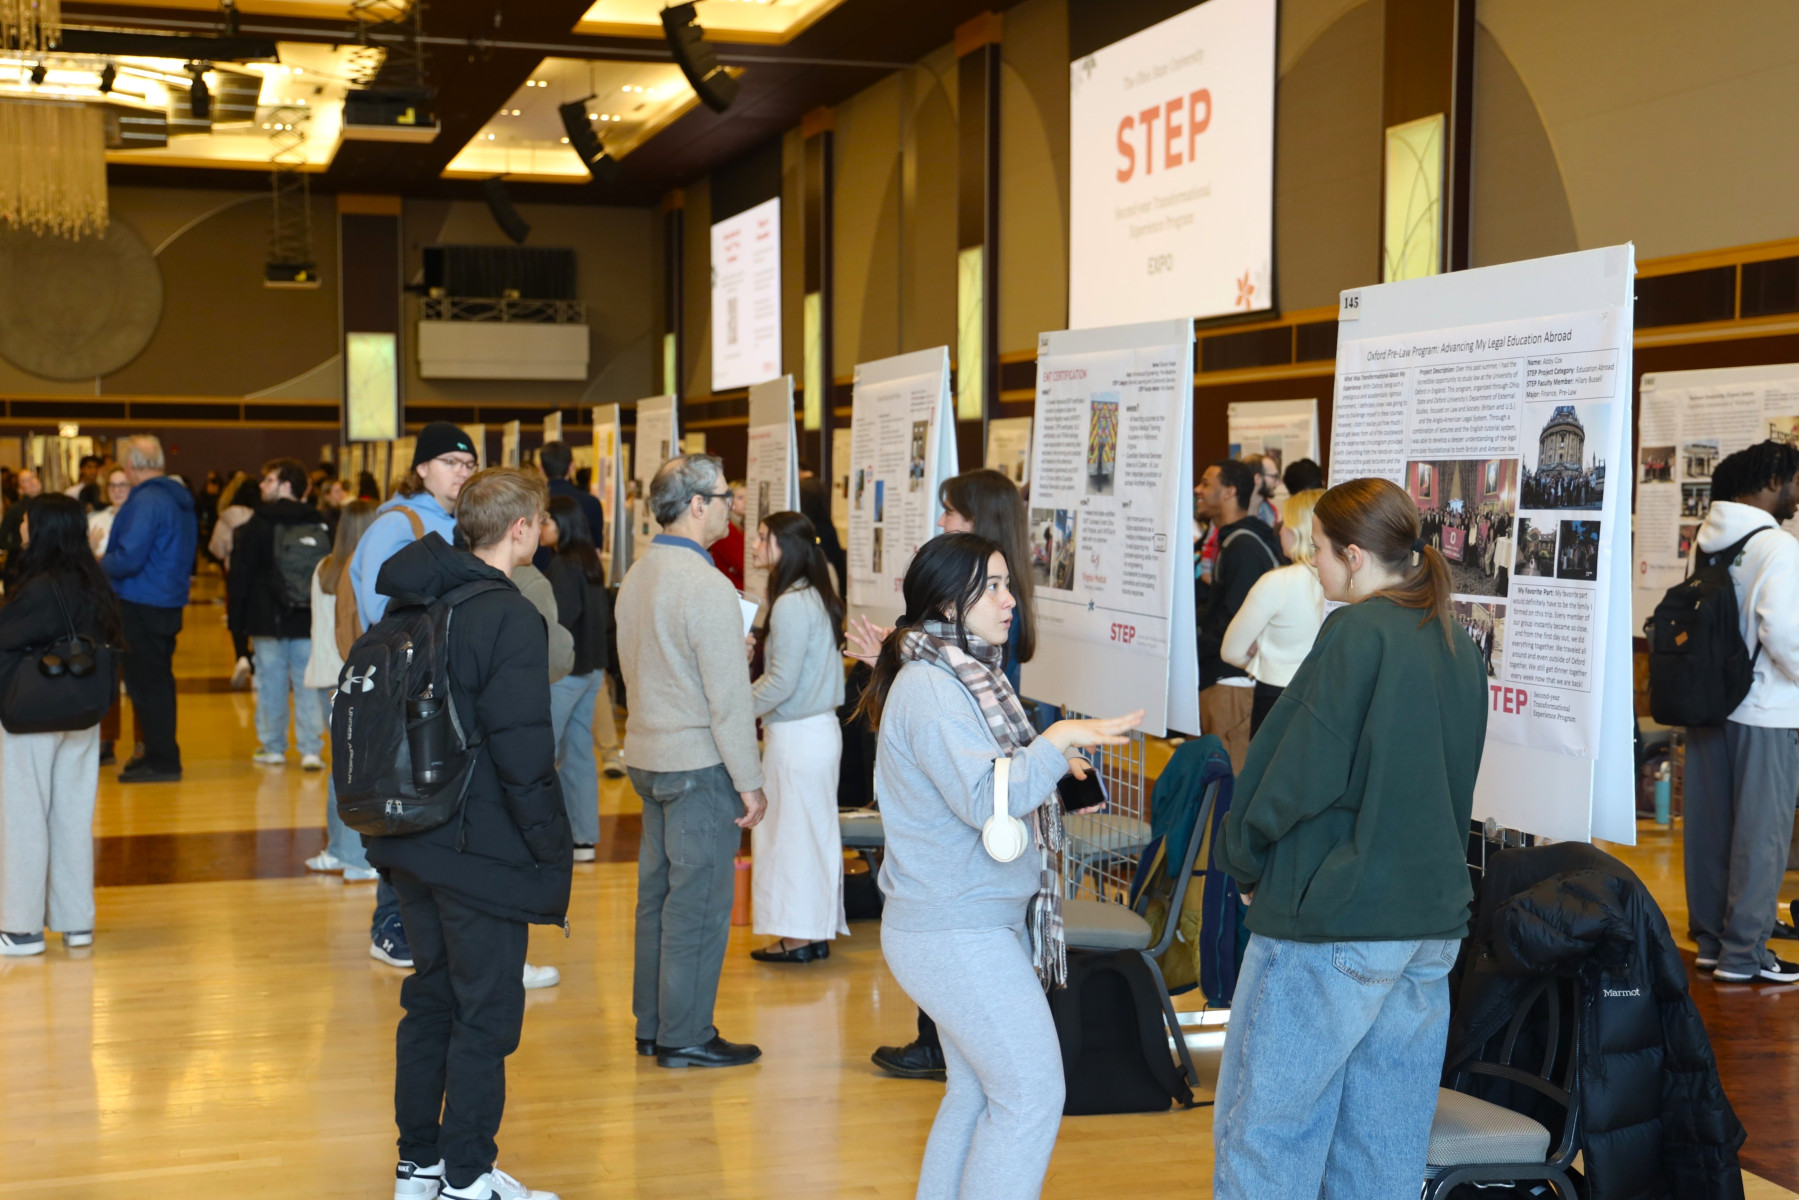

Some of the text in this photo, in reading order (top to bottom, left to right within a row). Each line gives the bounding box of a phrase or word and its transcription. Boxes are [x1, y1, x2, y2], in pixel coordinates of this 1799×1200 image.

[1116, 88, 1212, 184] STEP
[1148, 253, 1173, 275] EXPO
[1344, 296, 1359, 309] 145
[1367, 348, 1386, 360] Oxford
[1387, 345, 1410, 358] Pre-Law
[1411, 342, 1439, 359] Program:
[1440, 339, 1474, 356] Advancing
[1487, 336, 1505, 351] Legal
[1506, 332, 1542, 346] Education
[1543, 329, 1572, 343] Abroad
[1527, 363, 1615, 377] STEP Project Category: Education Abroad
[1578, 590, 1587, 600] part
[1525, 598, 1545, 608] definitely
[1576, 602, 1589, 611] family
[1544, 610, 1553, 619] trip.
[1553, 611, 1565, 620] Every
[1566, 612, 1584, 620] member
[1110, 622, 1136, 643] STEP
[1520, 620, 1532, 629] group
[1533, 620, 1552, 630] instantly
[1553, 622, 1570, 630] became
[1576, 624, 1588, 633] close,
[1561, 633, 1570, 642] out,
[1512, 639, 1534, 650] everything
[1534, 641, 1554, 652] together.
[1563, 644, 1580, 653] traveled
[1512, 650, 1526, 658] around
[1548, 654, 1564, 663] outside
[1570, 656, 1585, 665] Oxford
[1510, 660, 1527, 671] together.
[1536, 663, 1544, 671] still
[1553, 665, 1568, 674] dinner
[1568, 667, 1587, 678] together
[1511, 673, 1522, 681] every
[1522, 673, 1534, 681] week
[1571, 679, 1583, 687] back!
[1490, 684, 1528, 714] TEP
[1534, 700, 1570, 712] Transformational
[1533, 709, 1576, 724] Experience Program
[1603, 988, 1640, 997] Marmot
